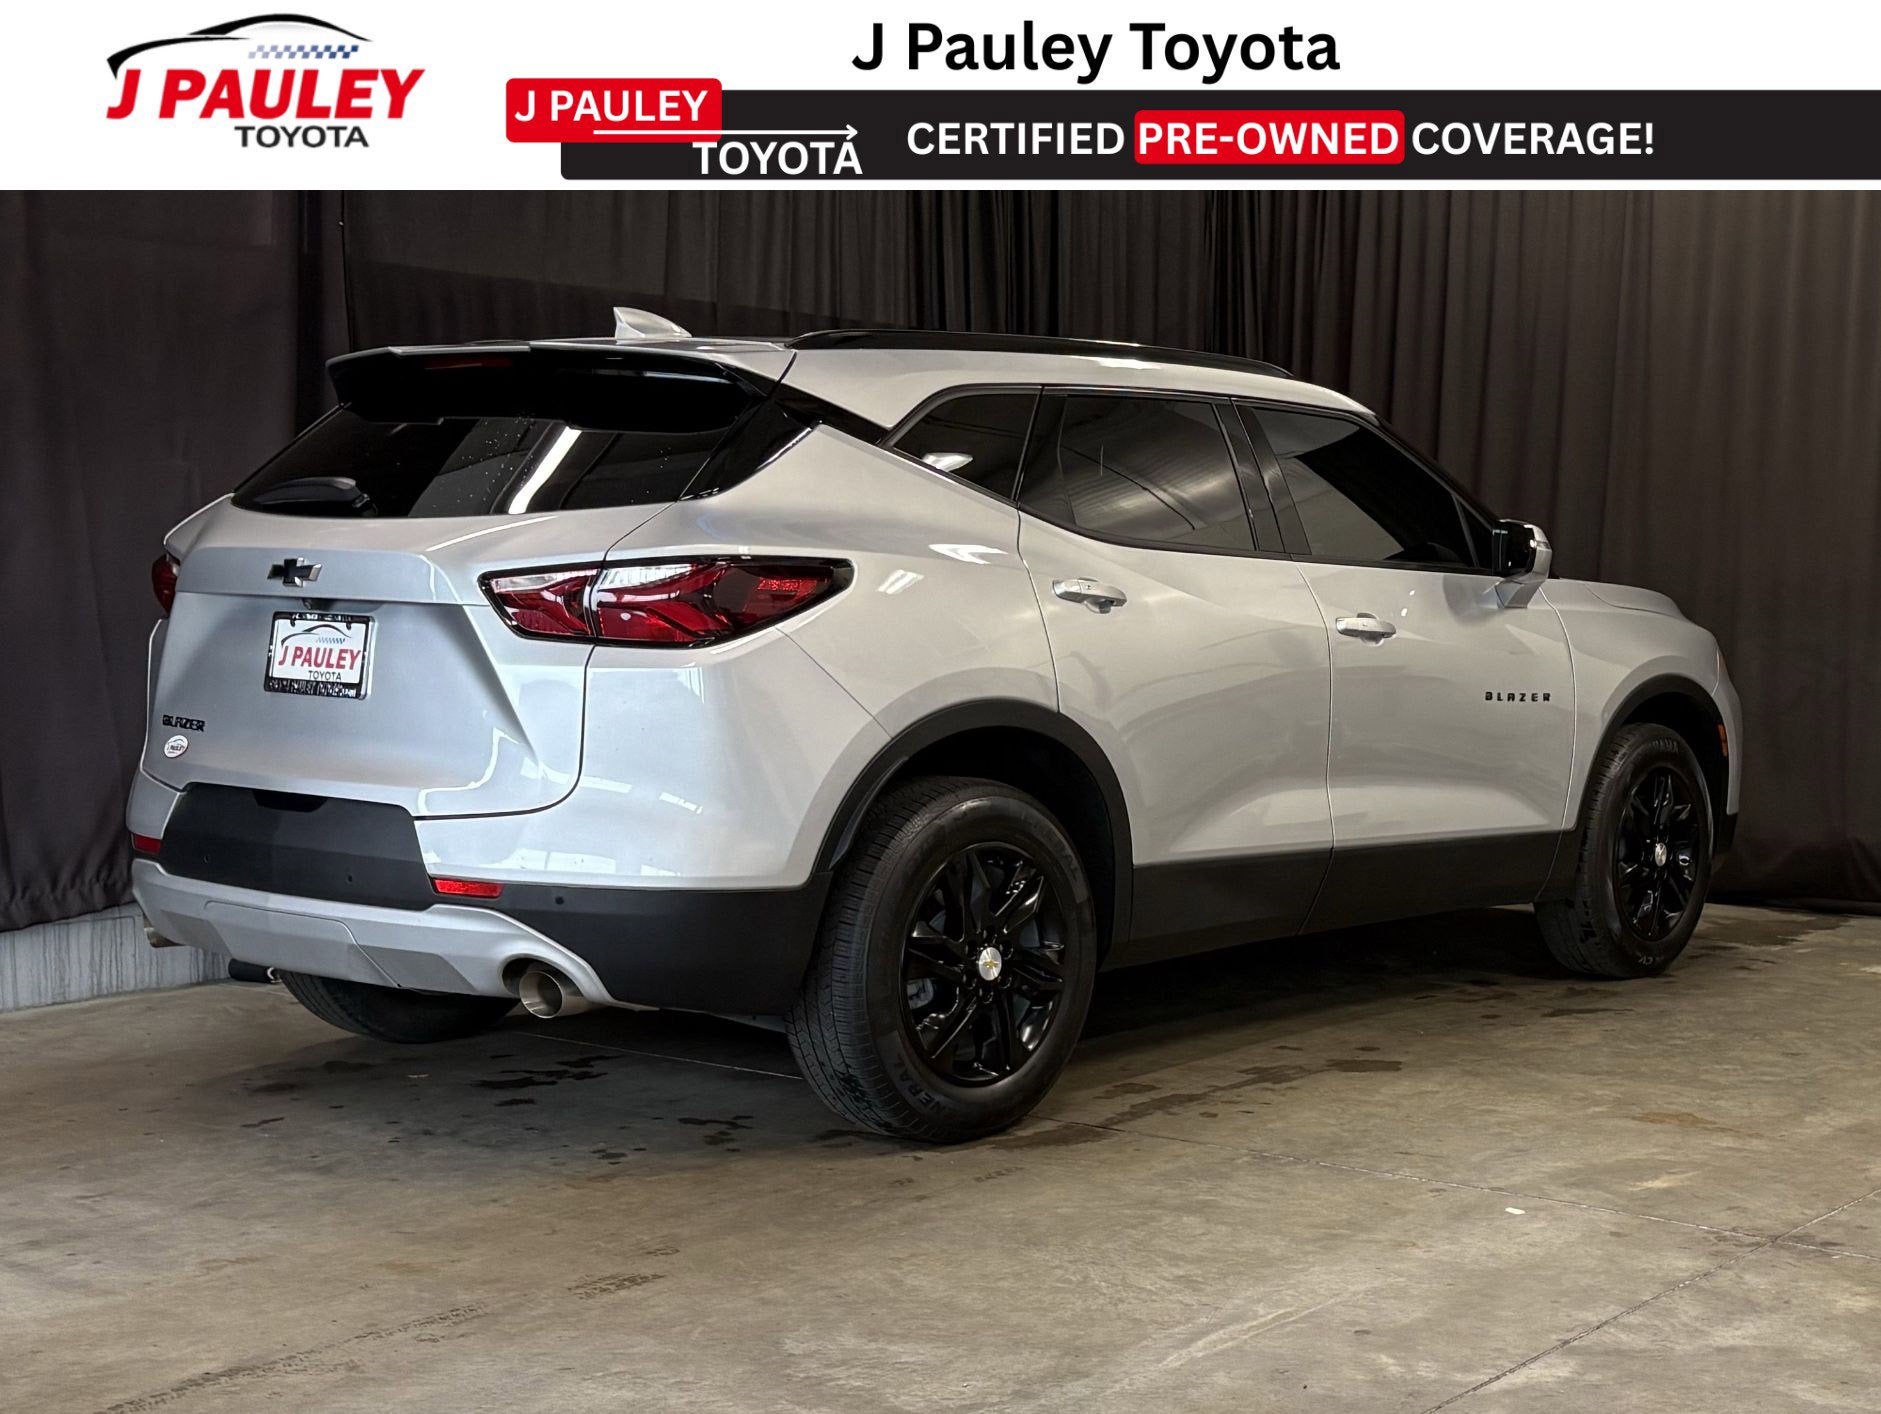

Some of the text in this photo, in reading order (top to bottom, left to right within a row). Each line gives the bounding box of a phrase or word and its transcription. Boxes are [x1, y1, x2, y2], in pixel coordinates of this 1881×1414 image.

[278, 645, 361, 670] J PAULEY
[308, 670, 342, 681] TOYOTA
[1485, 691, 1551, 702] BLAZER
[162, 714, 206, 732] BLAZER
